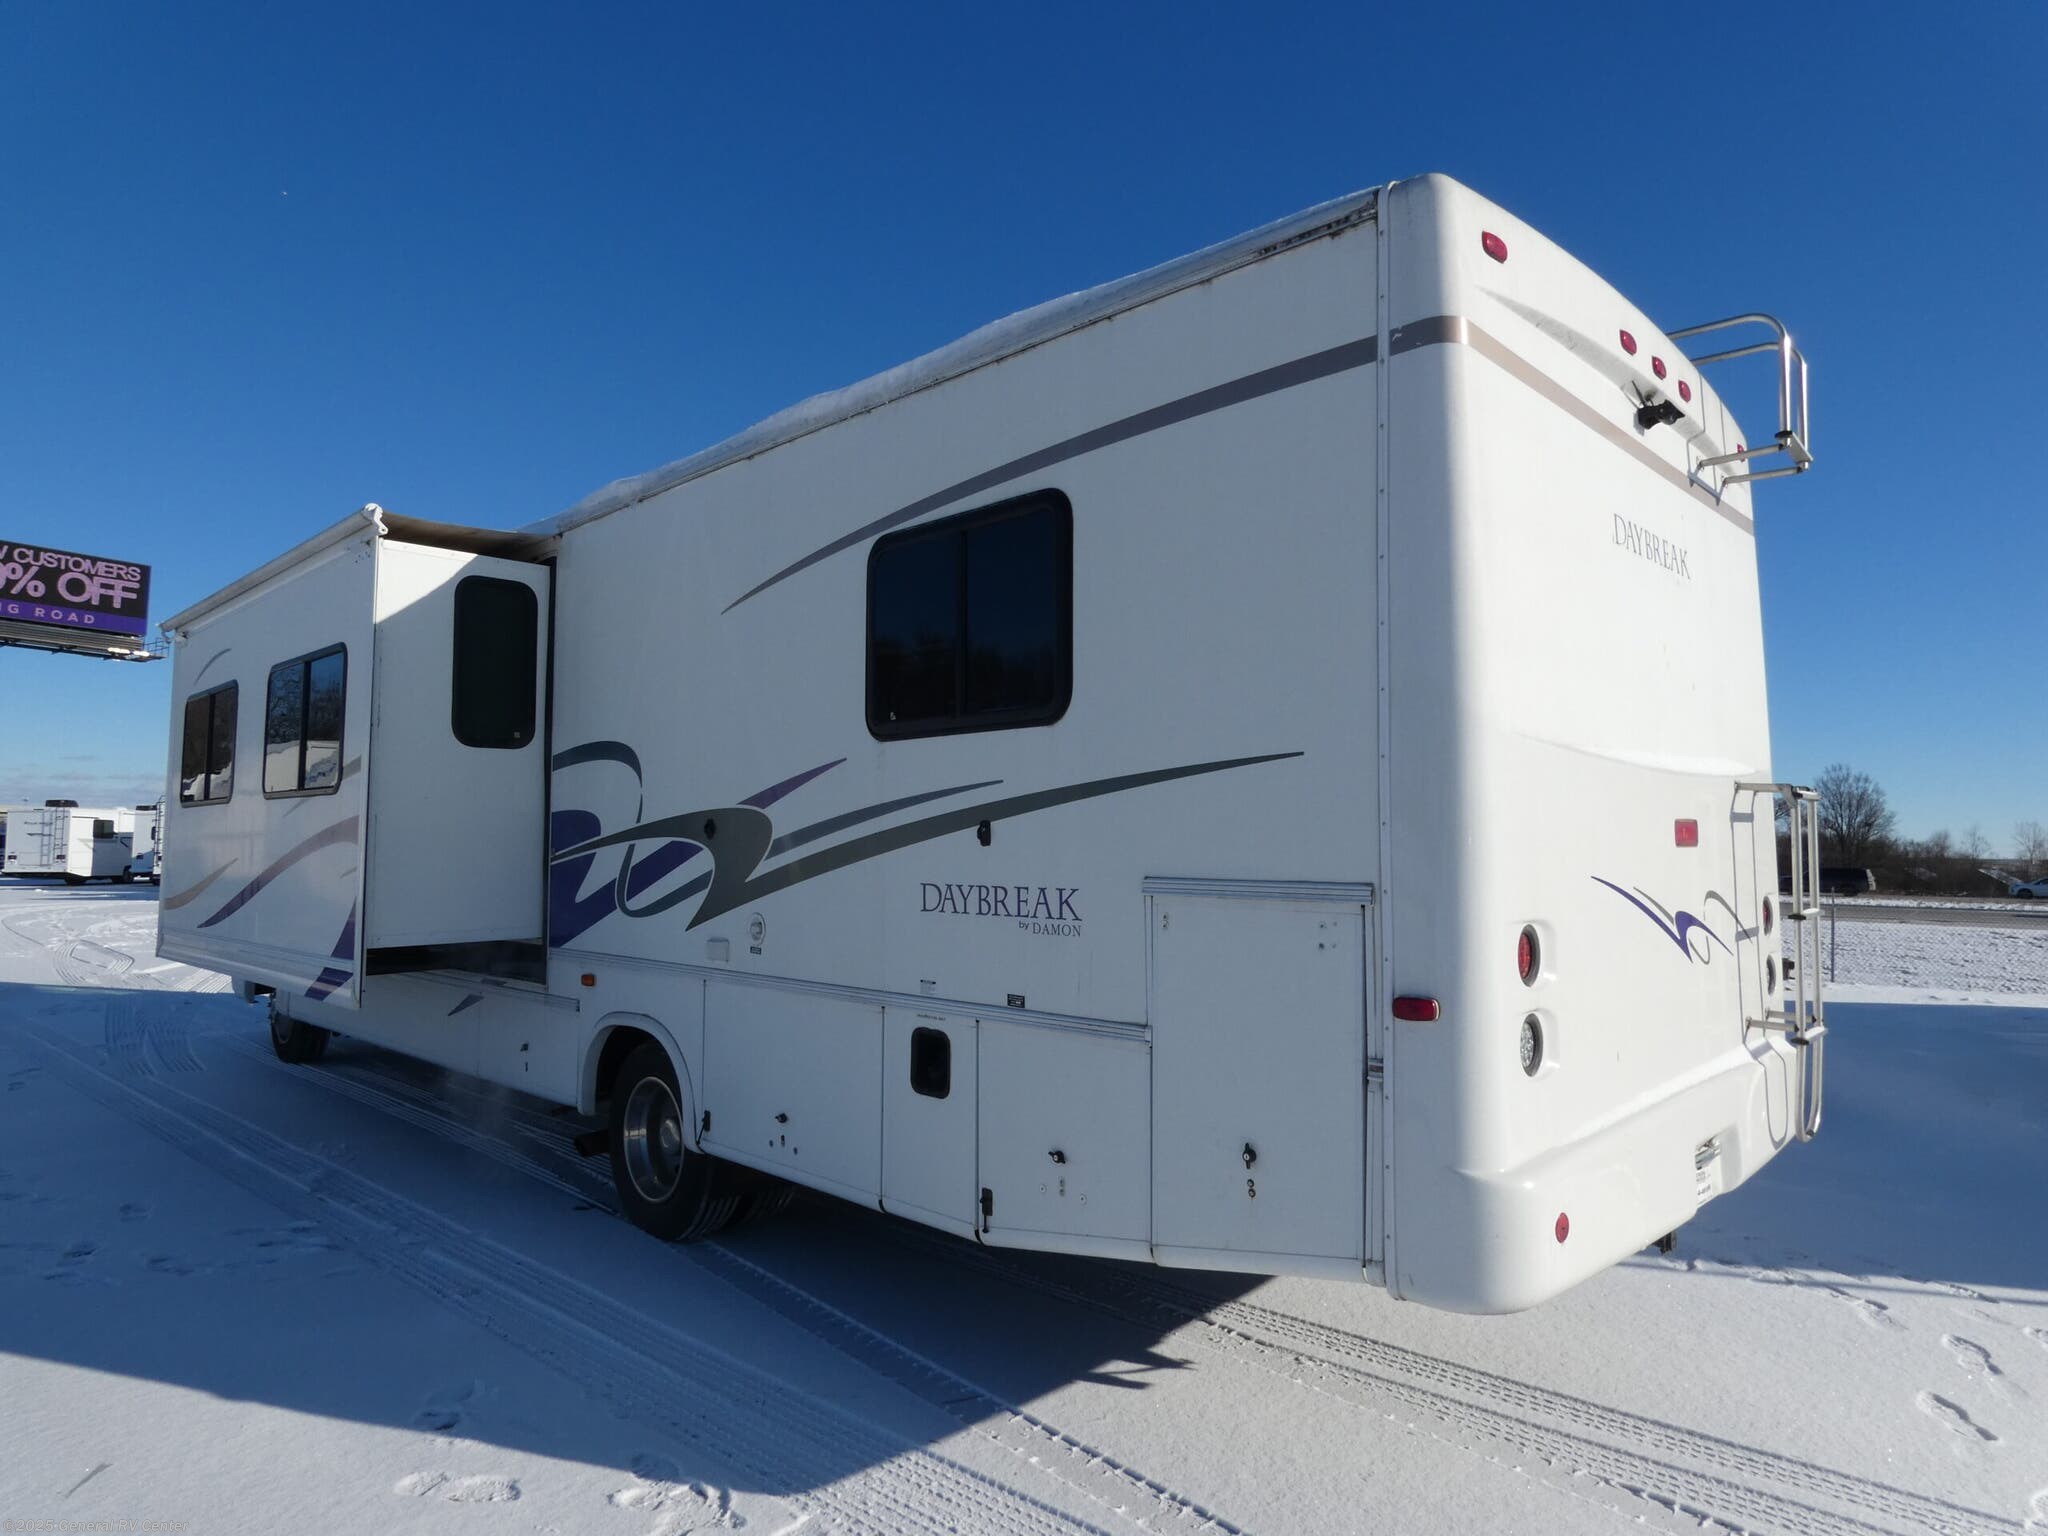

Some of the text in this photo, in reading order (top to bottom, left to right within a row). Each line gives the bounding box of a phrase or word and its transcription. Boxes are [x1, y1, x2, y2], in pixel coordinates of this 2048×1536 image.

[1613, 513, 1690, 579] DAYBREAK
[13, 547, 141, 582] CUSTOMERS
[57, 571, 140, 608] OFF
[0, 603, 95, 624] G ROAD
[920, 882, 1082, 921] DAYBREAK
[1018, 920, 1082, 938] by DAMON
